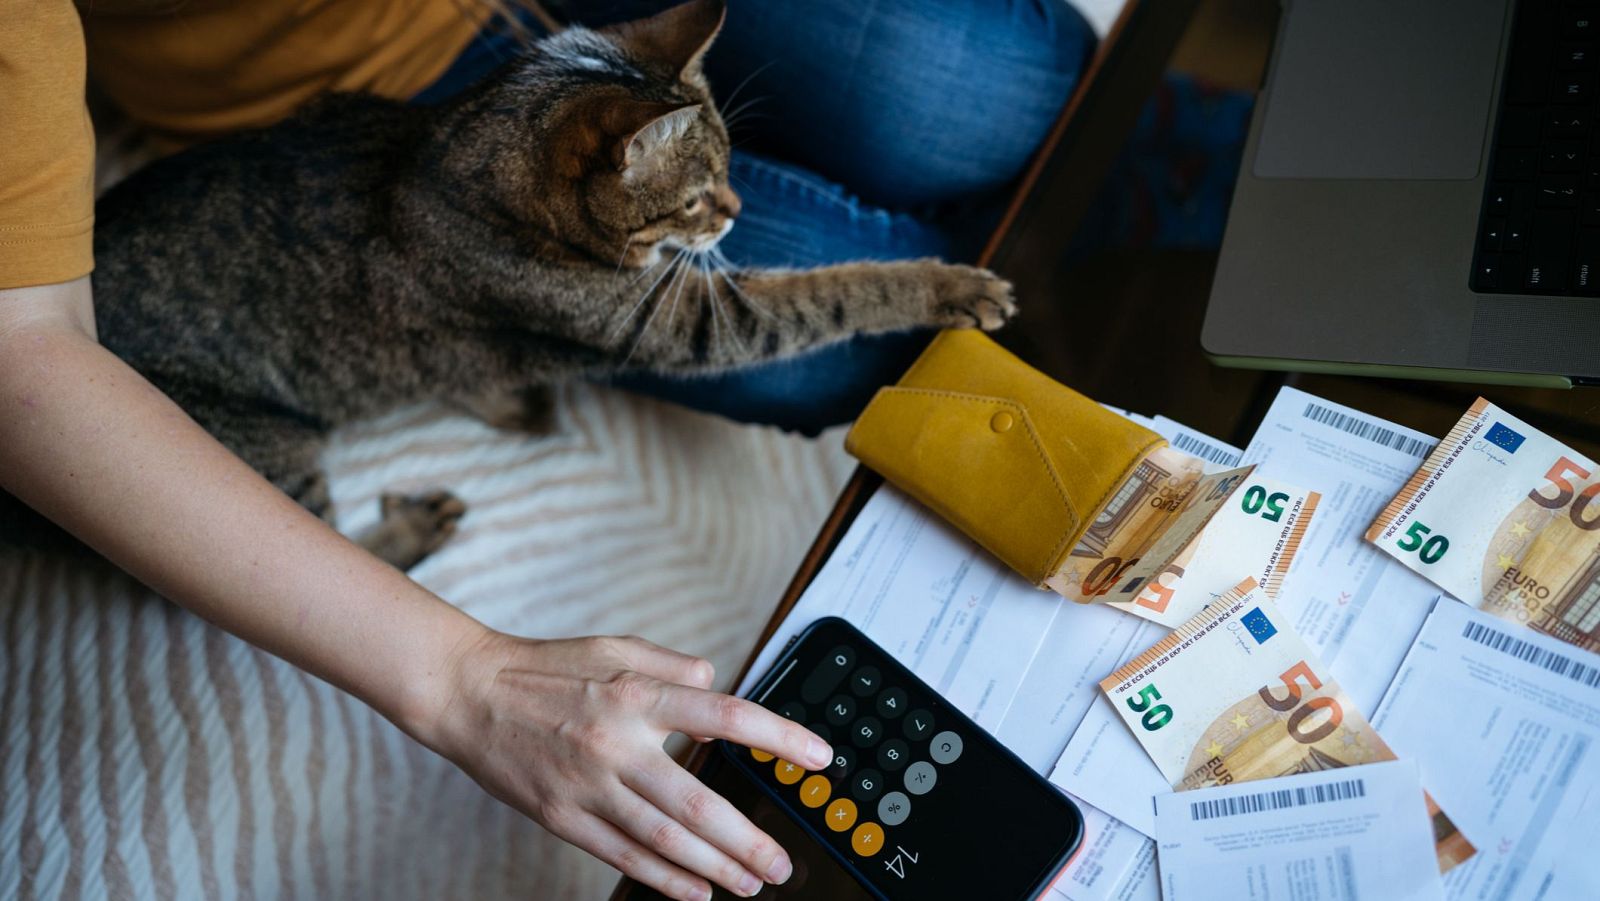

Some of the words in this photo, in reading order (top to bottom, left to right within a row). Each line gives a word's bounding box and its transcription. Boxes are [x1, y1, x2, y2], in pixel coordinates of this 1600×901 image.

[1530, 267, 1540, 284] shift
[1580, 264, 1588, 286] return
[1395, 514, 1408, 527] ECB
[1415, 491, 1427, 503] EZB
[1424, 479, 1435, 492] EKP
[1442, 457, 1455, 469] ESB
[1452, 445, 1464, 458] EKB
[1471, 422, 1483, 434] EBC
[1240, 484, 1290, 523] 50
[1527, 455, 1600, 532] 50
[1396, 520, 1450, 565] 50
[1136, 564, 1185, 614] 5
[1503, 566, 1550, 600] EURO
[1131, 673, 1145, 684] ECB
[1156, 656, 1170, 667] EZB
[1168, 647, 1182, 658] EKP
[1193, 630, 1207, 641] ESB
[1205, 620, 1219, 632] EKB
[1230, 602, 1244, 614] EBC
[835, 655, 847, 666] 0
[861, 677, 872, 686] 1
[834, 704, 847, 716] 2
[886, 697, 897, 709] 4
[1126, 682, 1174, 732] 50
[1258, 660, 1344, 745] 50
[861, 726, 873, 738] 5
[914, 719, 926, 732] 7
[887, 749, 899, 760] 8
[941, 742, 951, 753] C
[884, 845, 919, 879] 14
